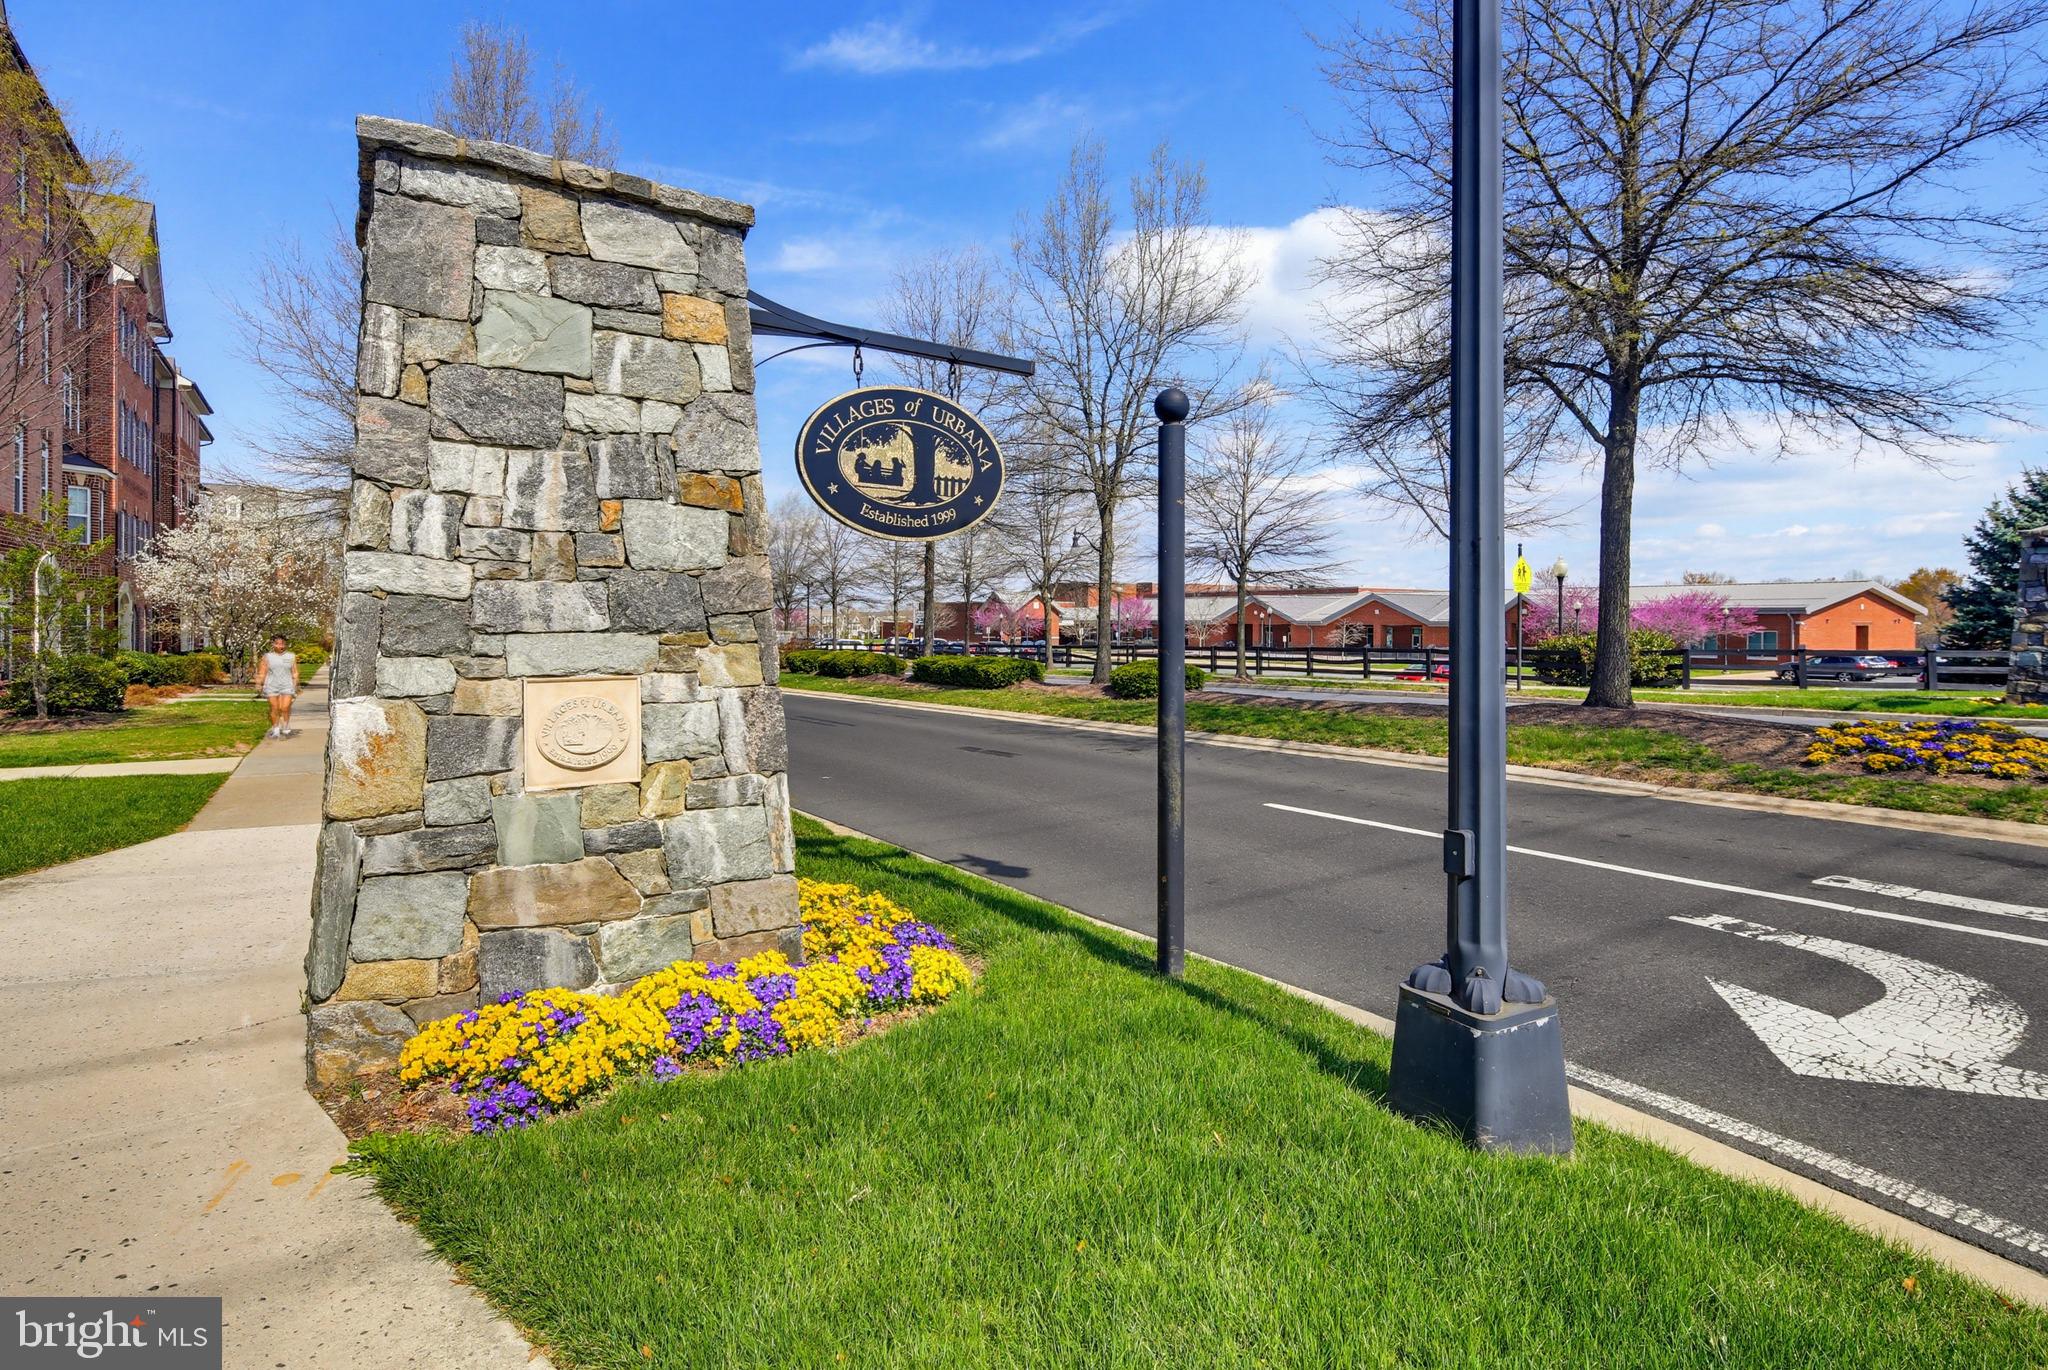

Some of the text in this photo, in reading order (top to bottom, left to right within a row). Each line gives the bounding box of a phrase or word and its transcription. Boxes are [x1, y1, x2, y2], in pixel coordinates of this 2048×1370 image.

[816, 398, 993, 472] VILLAGES of URBANA
[860, 503, 957, 527] Established 1999
[541, 699, 581, 738] VILLAGES
